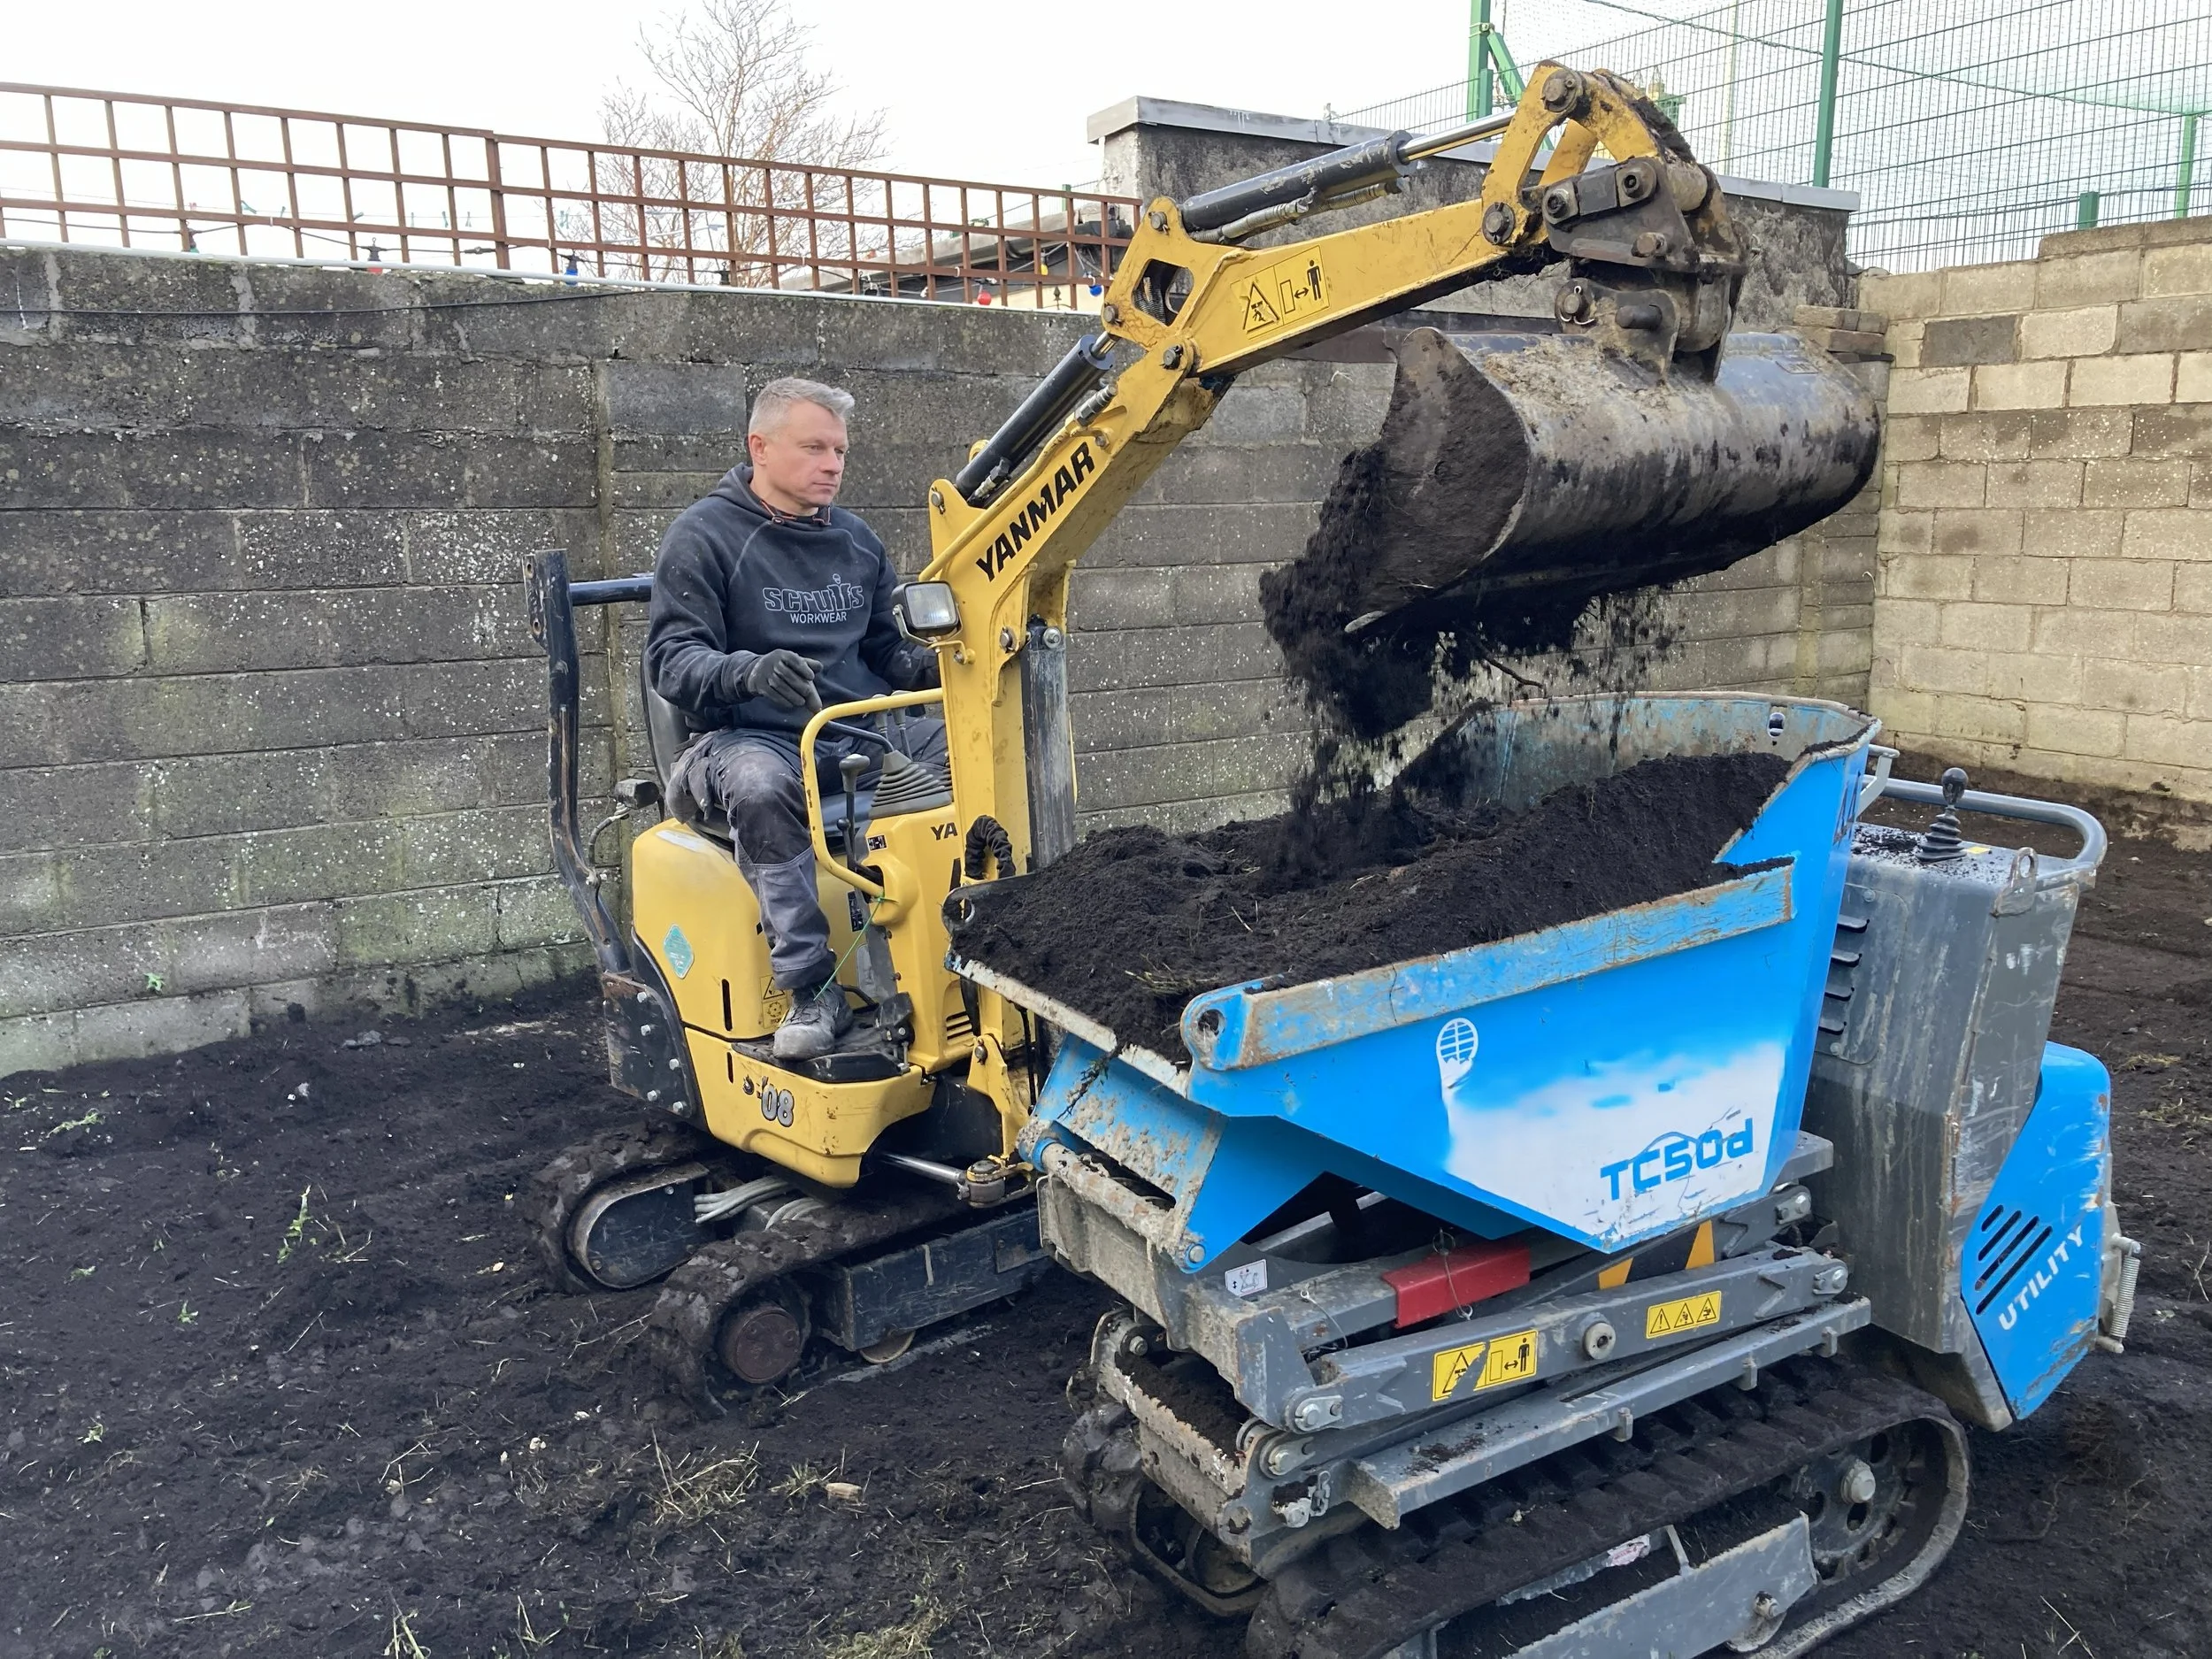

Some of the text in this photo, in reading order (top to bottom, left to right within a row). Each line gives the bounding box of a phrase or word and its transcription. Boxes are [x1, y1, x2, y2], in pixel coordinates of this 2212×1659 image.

[975, 442, 1094, 582] YANMAR
[790, 611, 847, 624] WORKWEAR
[1600, 1118, 1753, 1201] TC50d
[1999, 1225, 2083, 1330] UTILITY
